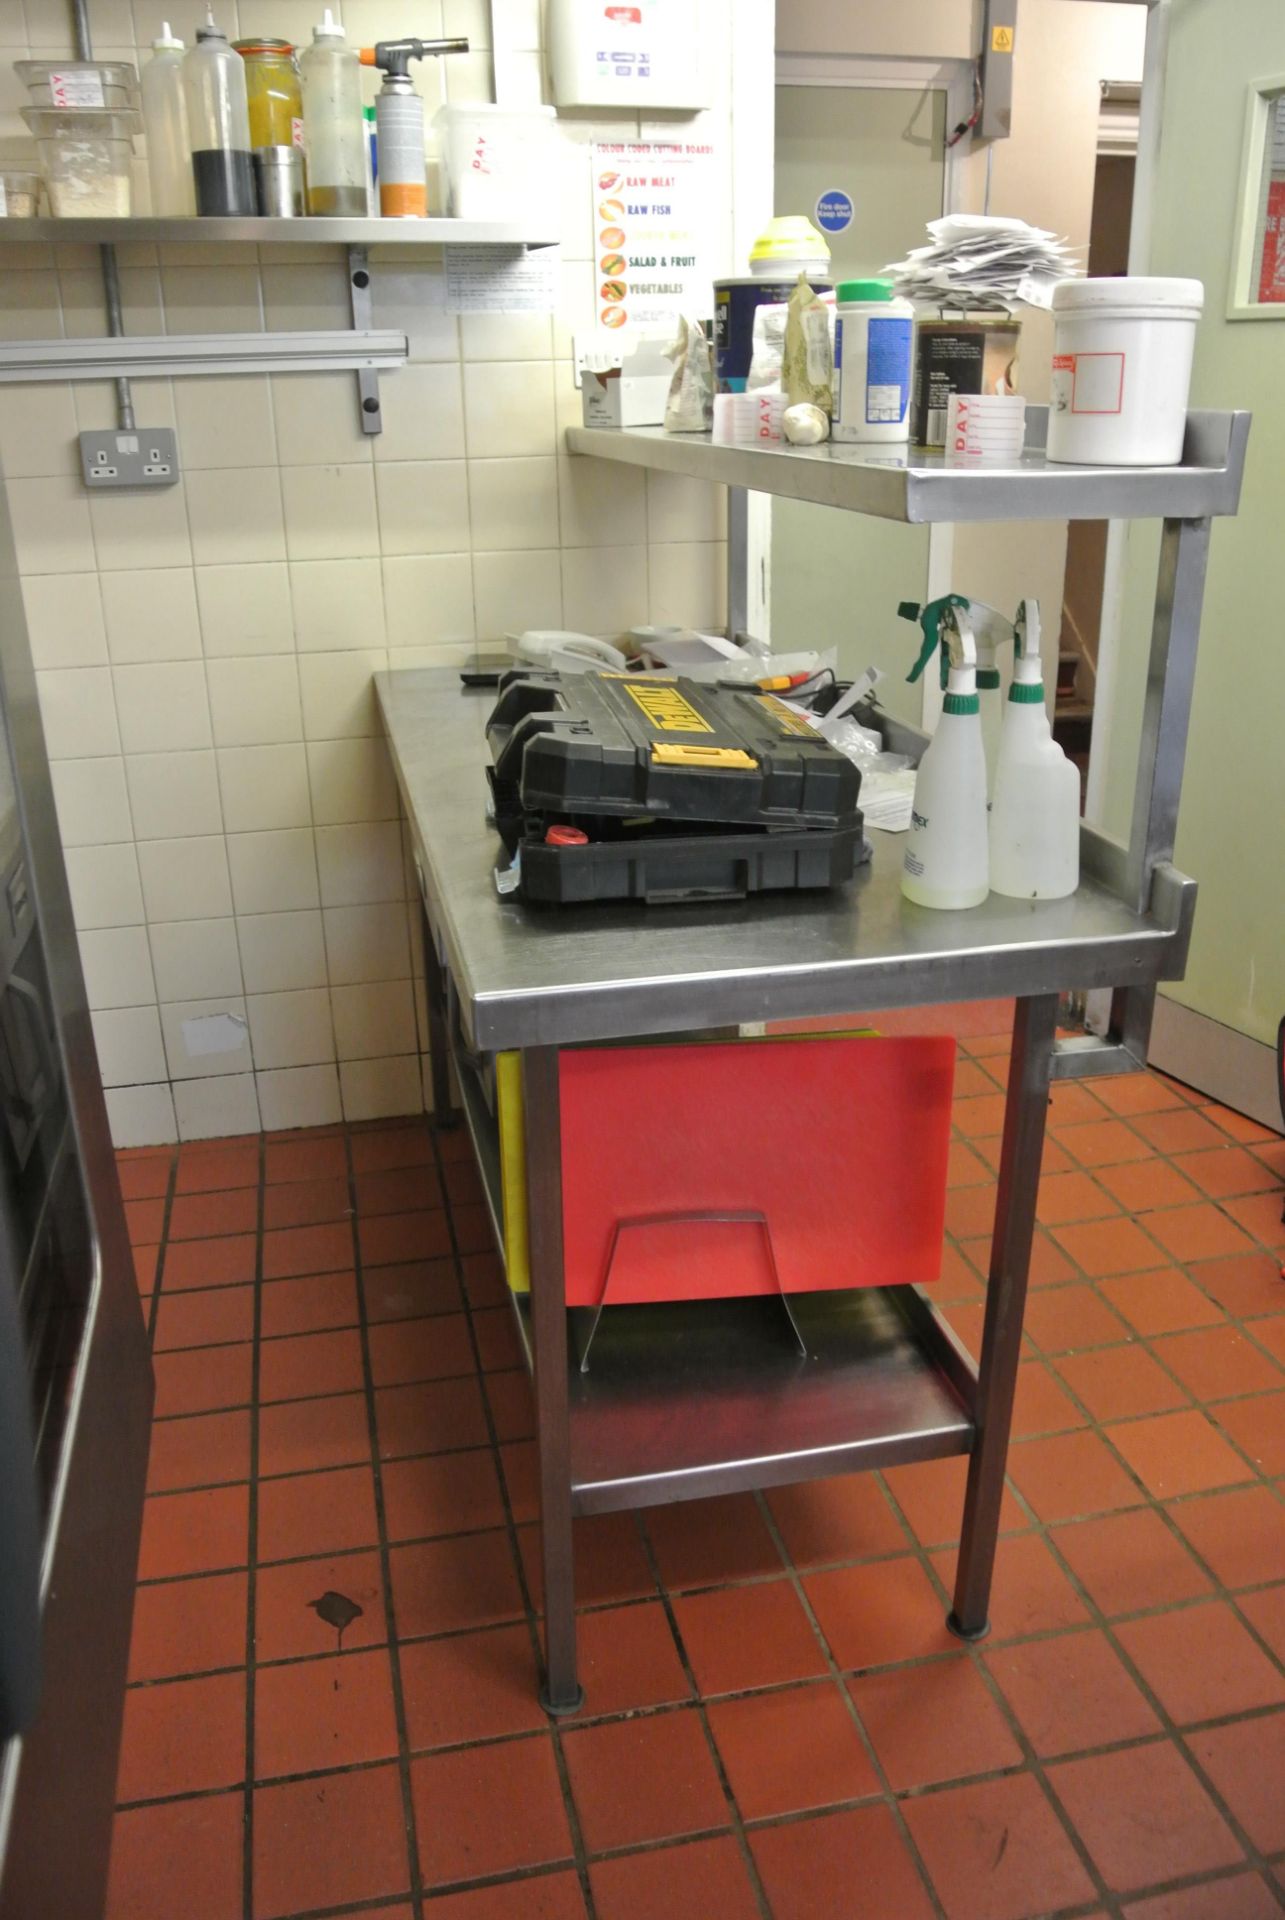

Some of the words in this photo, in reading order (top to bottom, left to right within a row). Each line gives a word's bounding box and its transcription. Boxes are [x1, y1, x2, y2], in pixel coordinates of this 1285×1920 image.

[472, 136, 486, 169] DAY
[626, 177, 647, 186] RAW
[651, 177, 675, 186] MEAT
[627, 205, 648, 215] RAW
[652, 205, 672, 215] FISH
[629, 256, 657, 267] SALAD
[660, 256, 667, 267] &
[670, 256, 696, 267] FRUIT
[629, 283, 683, 294] VEGETABLES
[760, 399, 770, 437] DAY
[956, 401, 968, 451] DAY
